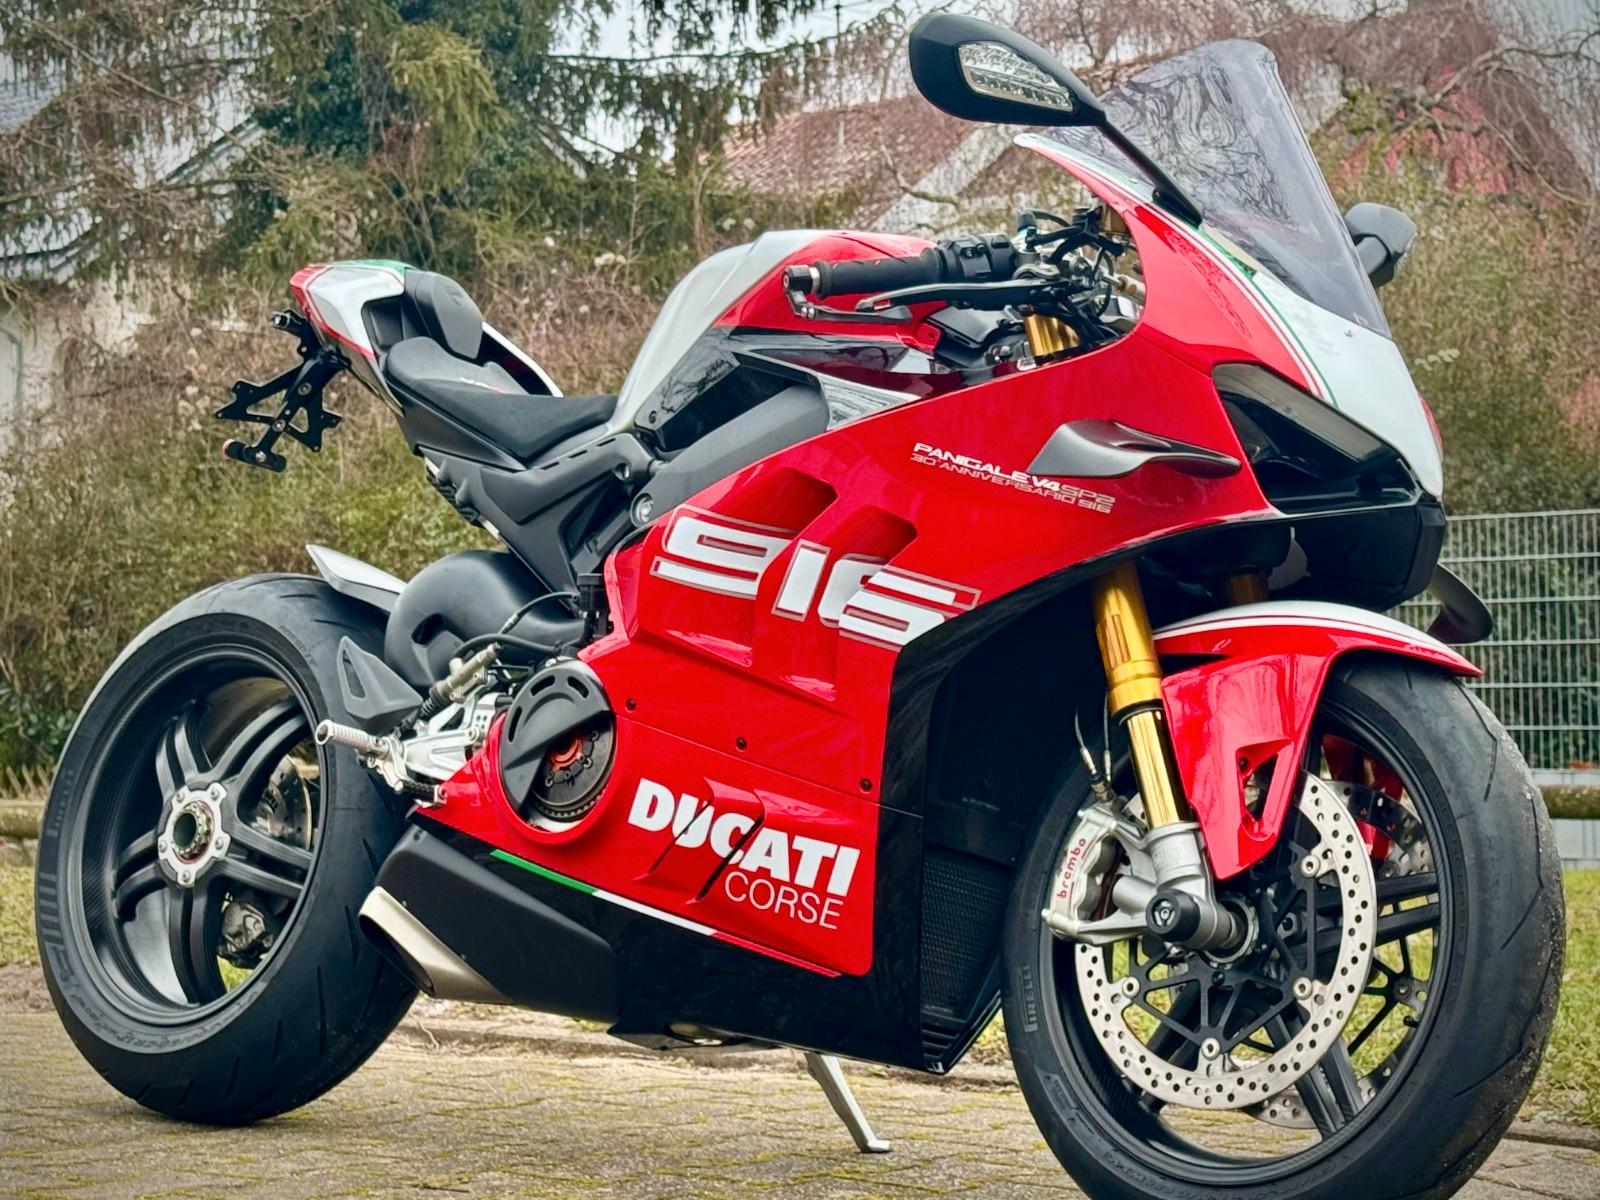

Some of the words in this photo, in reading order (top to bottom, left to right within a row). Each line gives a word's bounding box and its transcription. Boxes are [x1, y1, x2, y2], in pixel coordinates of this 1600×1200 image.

[914, 442, 1031, 482] PANIGALE
[1078, 499, 1113, 514] 916
[650, 504, 982, 652] 916
[628, 778, 860, 897] DUCATI
[1057, 838, 1087, 899] brembo
[725, 871, 844, 930] CORSE
[1017, 965, 1039, 1033] PIRELLI
